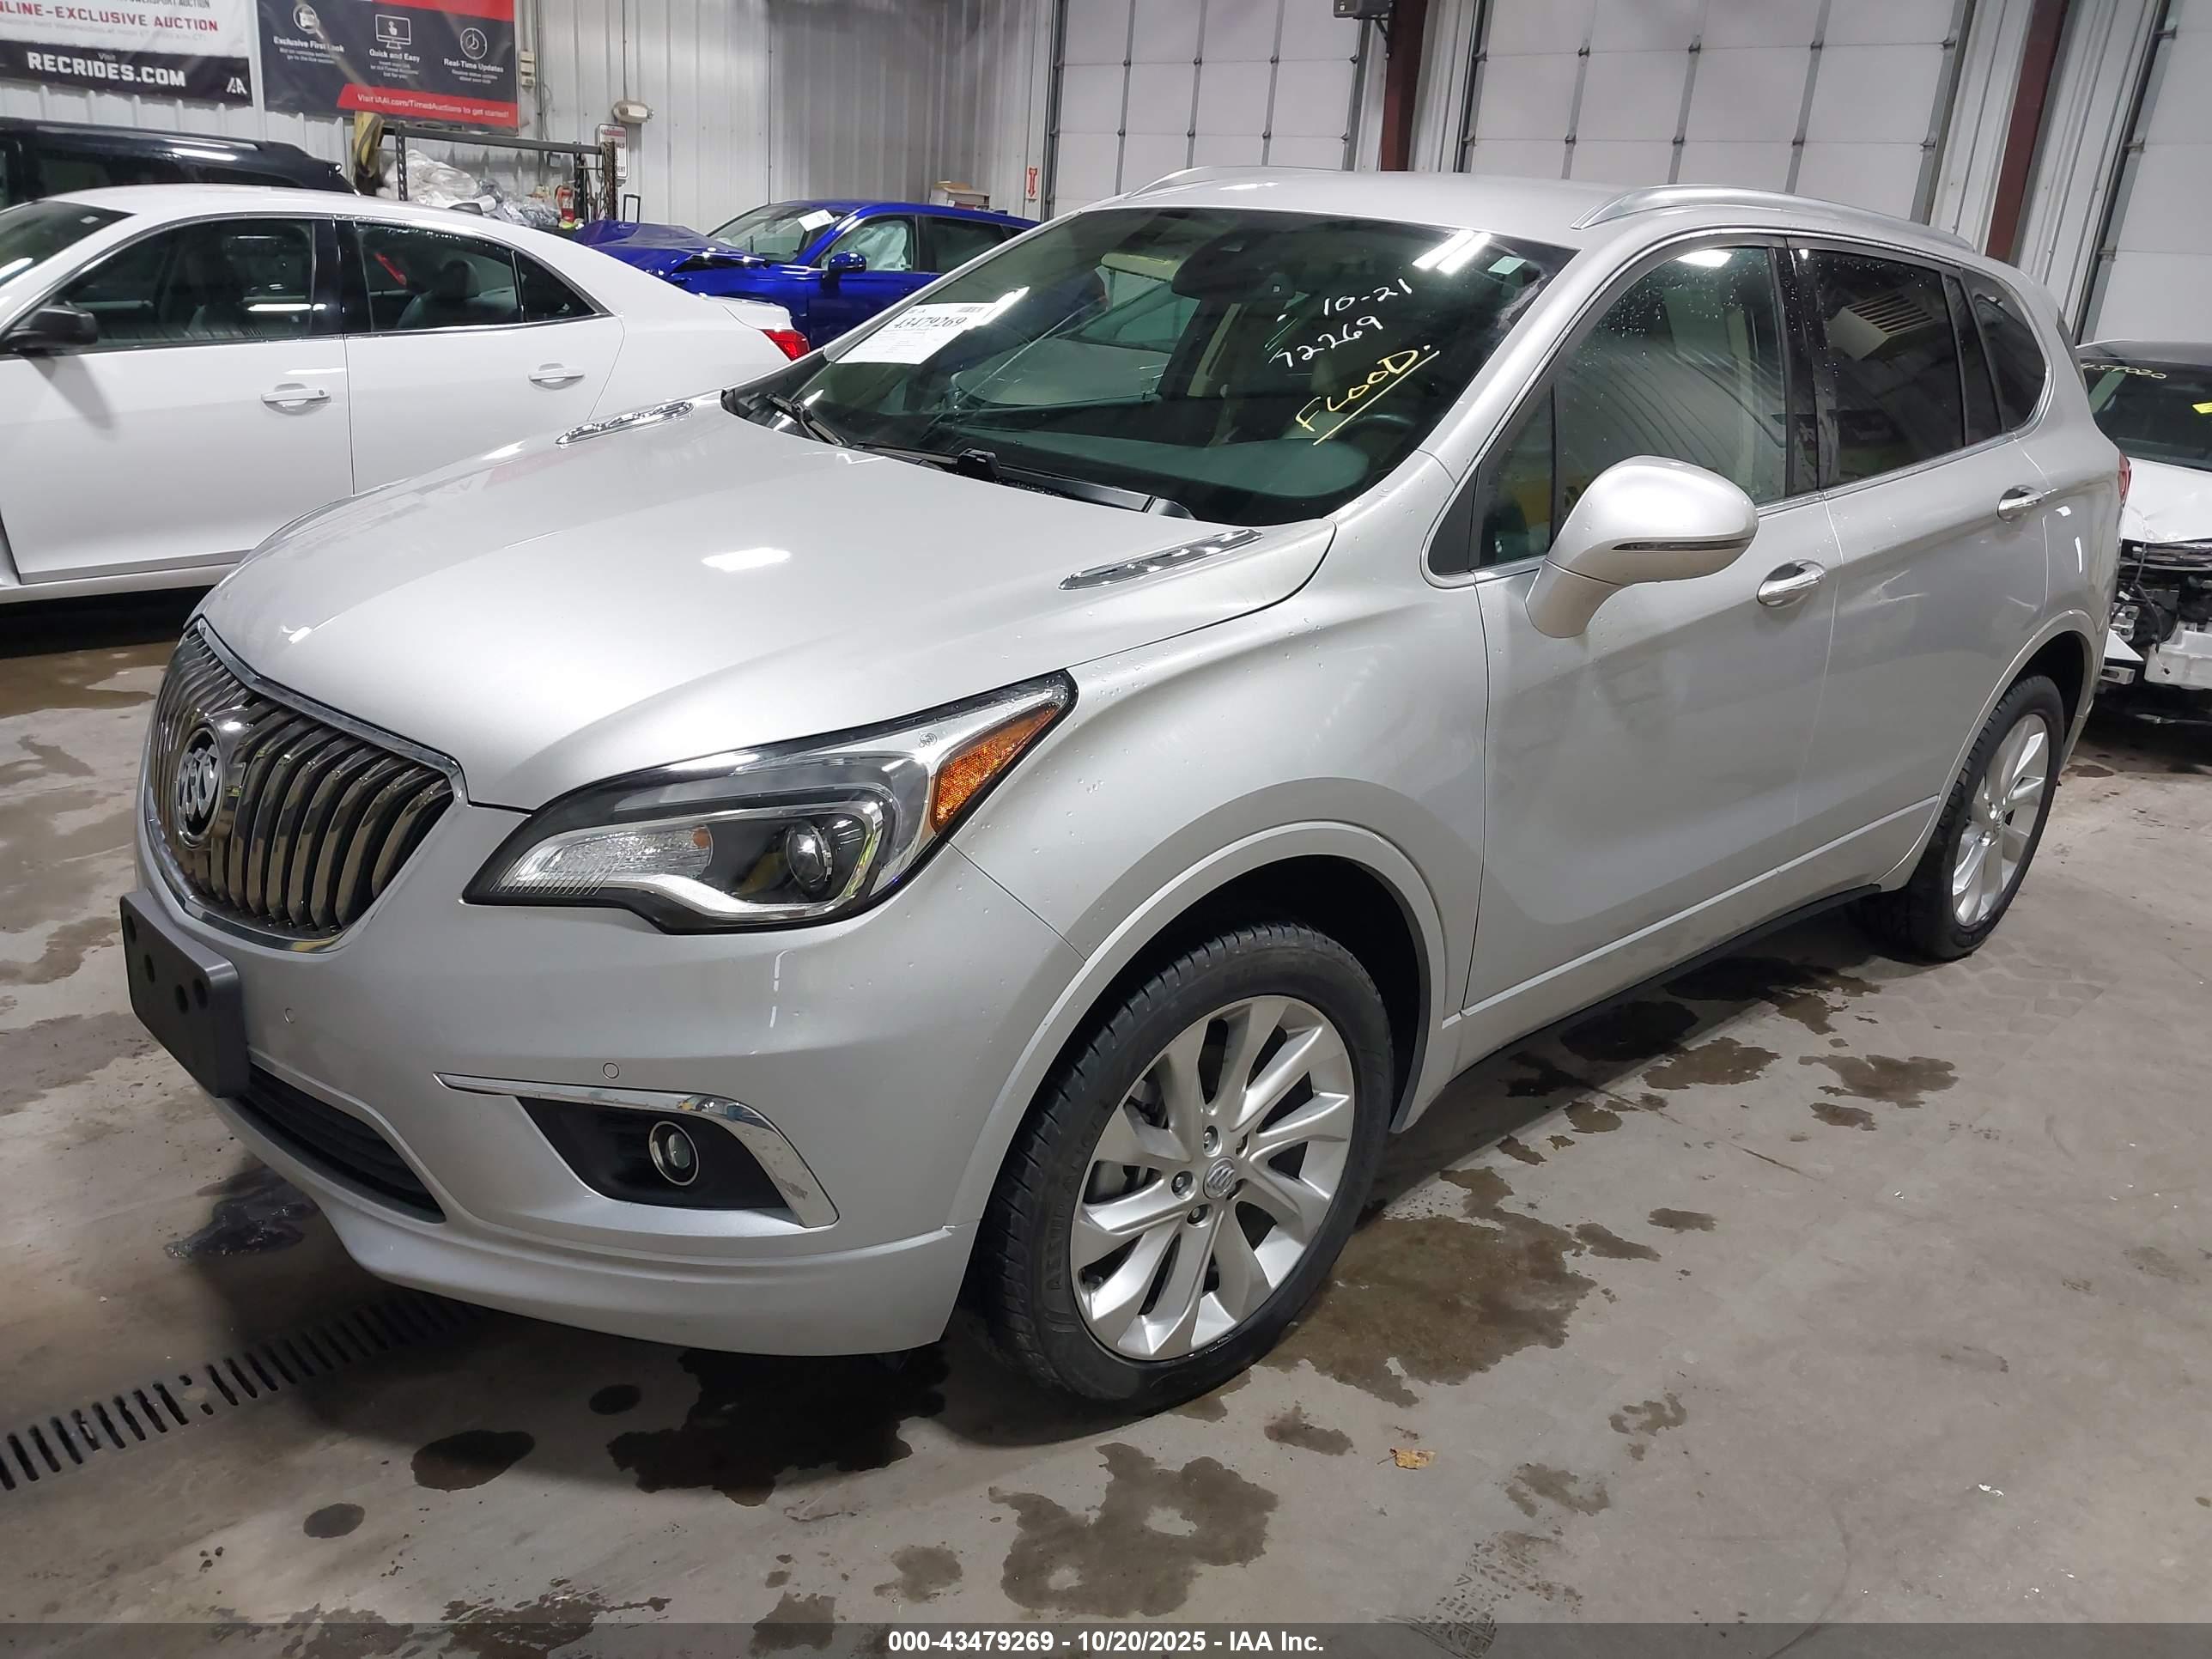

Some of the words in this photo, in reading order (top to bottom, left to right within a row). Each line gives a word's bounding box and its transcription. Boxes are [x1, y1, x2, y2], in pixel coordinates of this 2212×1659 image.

[155, 15, 218, 31] AUCTION
[273, 36, 309, 48] Exclusive
[310, 40, 326, 50] First
[369, 48, 388, 58] Quick
[404, 52, 420, 63] Easy
[27, 52, 185, 87] RECRIDES.COM
[443, 58, 477, 70] Real-Time
[477, 63, 504, 73] Updates
[357, 94, 374, 103] Visit
[463, 106, 471, 114] to
[1323, 278, 1413, 316] 10-21
[1276, 315, 1383, 368] 72269
